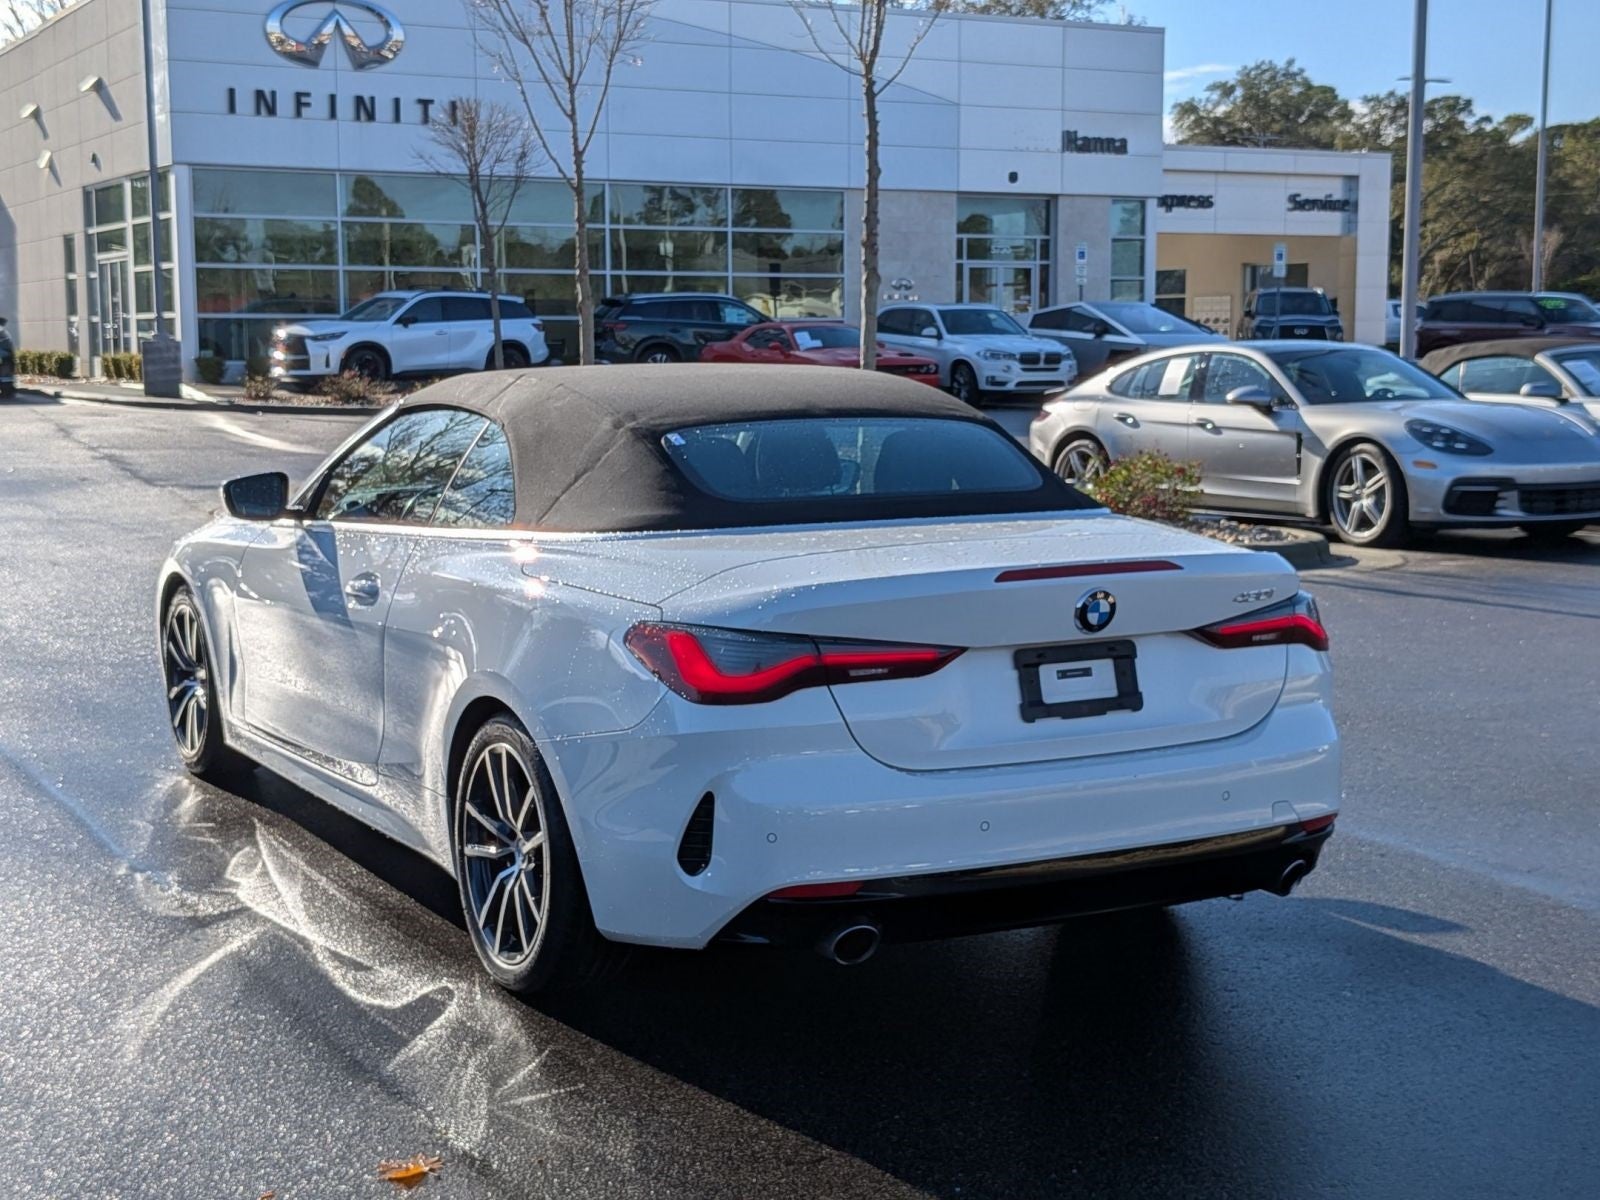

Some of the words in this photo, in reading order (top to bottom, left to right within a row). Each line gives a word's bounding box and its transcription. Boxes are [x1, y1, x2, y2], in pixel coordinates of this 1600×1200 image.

[227, 87, 458, 126] INFINITI
[1062, 130, 1128, 155] Hanna
[1287, 193, 1355, 212] Service
